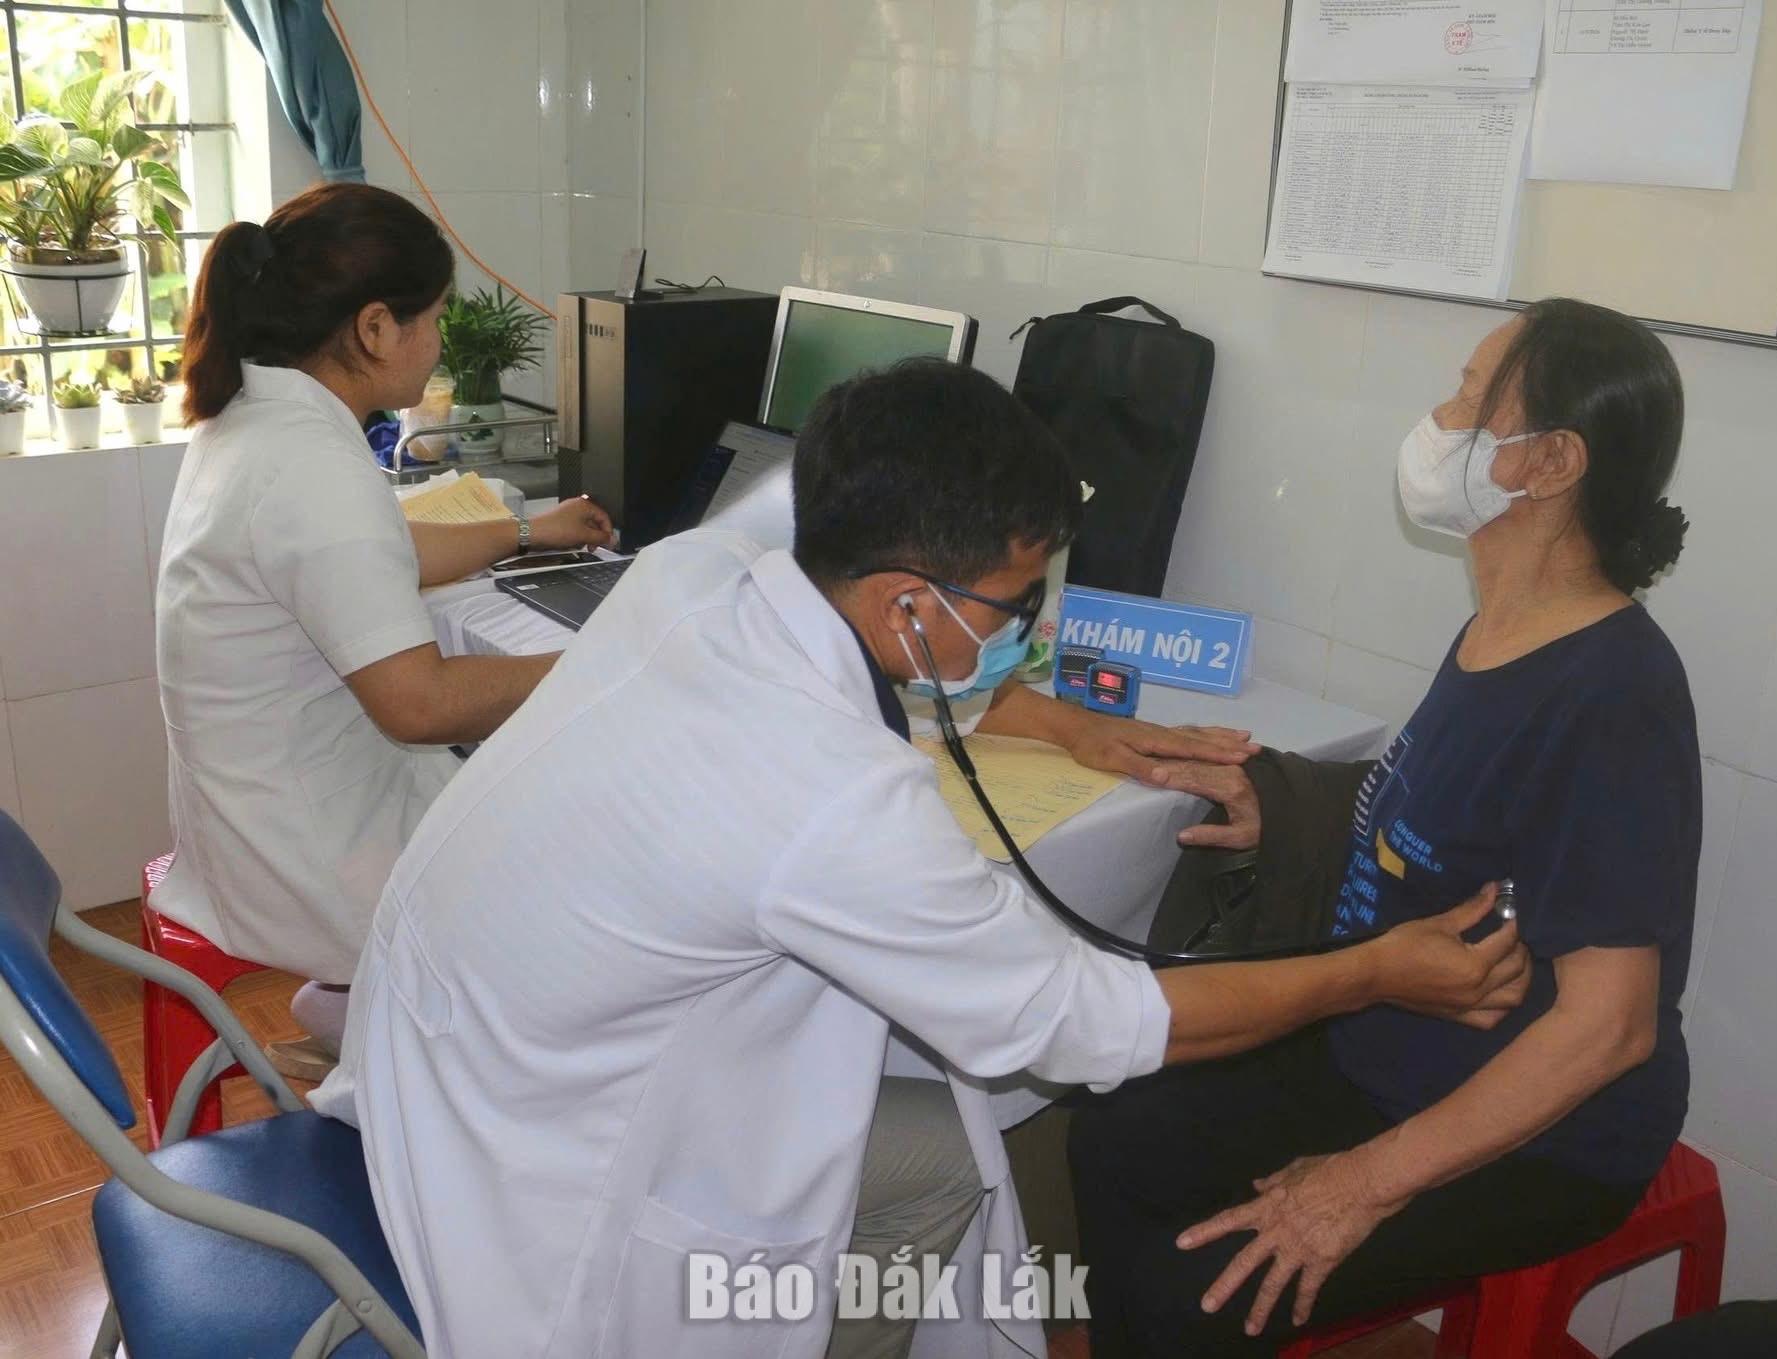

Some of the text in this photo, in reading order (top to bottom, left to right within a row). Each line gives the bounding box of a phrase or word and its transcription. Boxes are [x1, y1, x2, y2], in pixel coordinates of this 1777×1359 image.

[1061, 617, 1230, 669] KHÁM NỘI 2
[1404, 843, 1443, 872] WORLD
